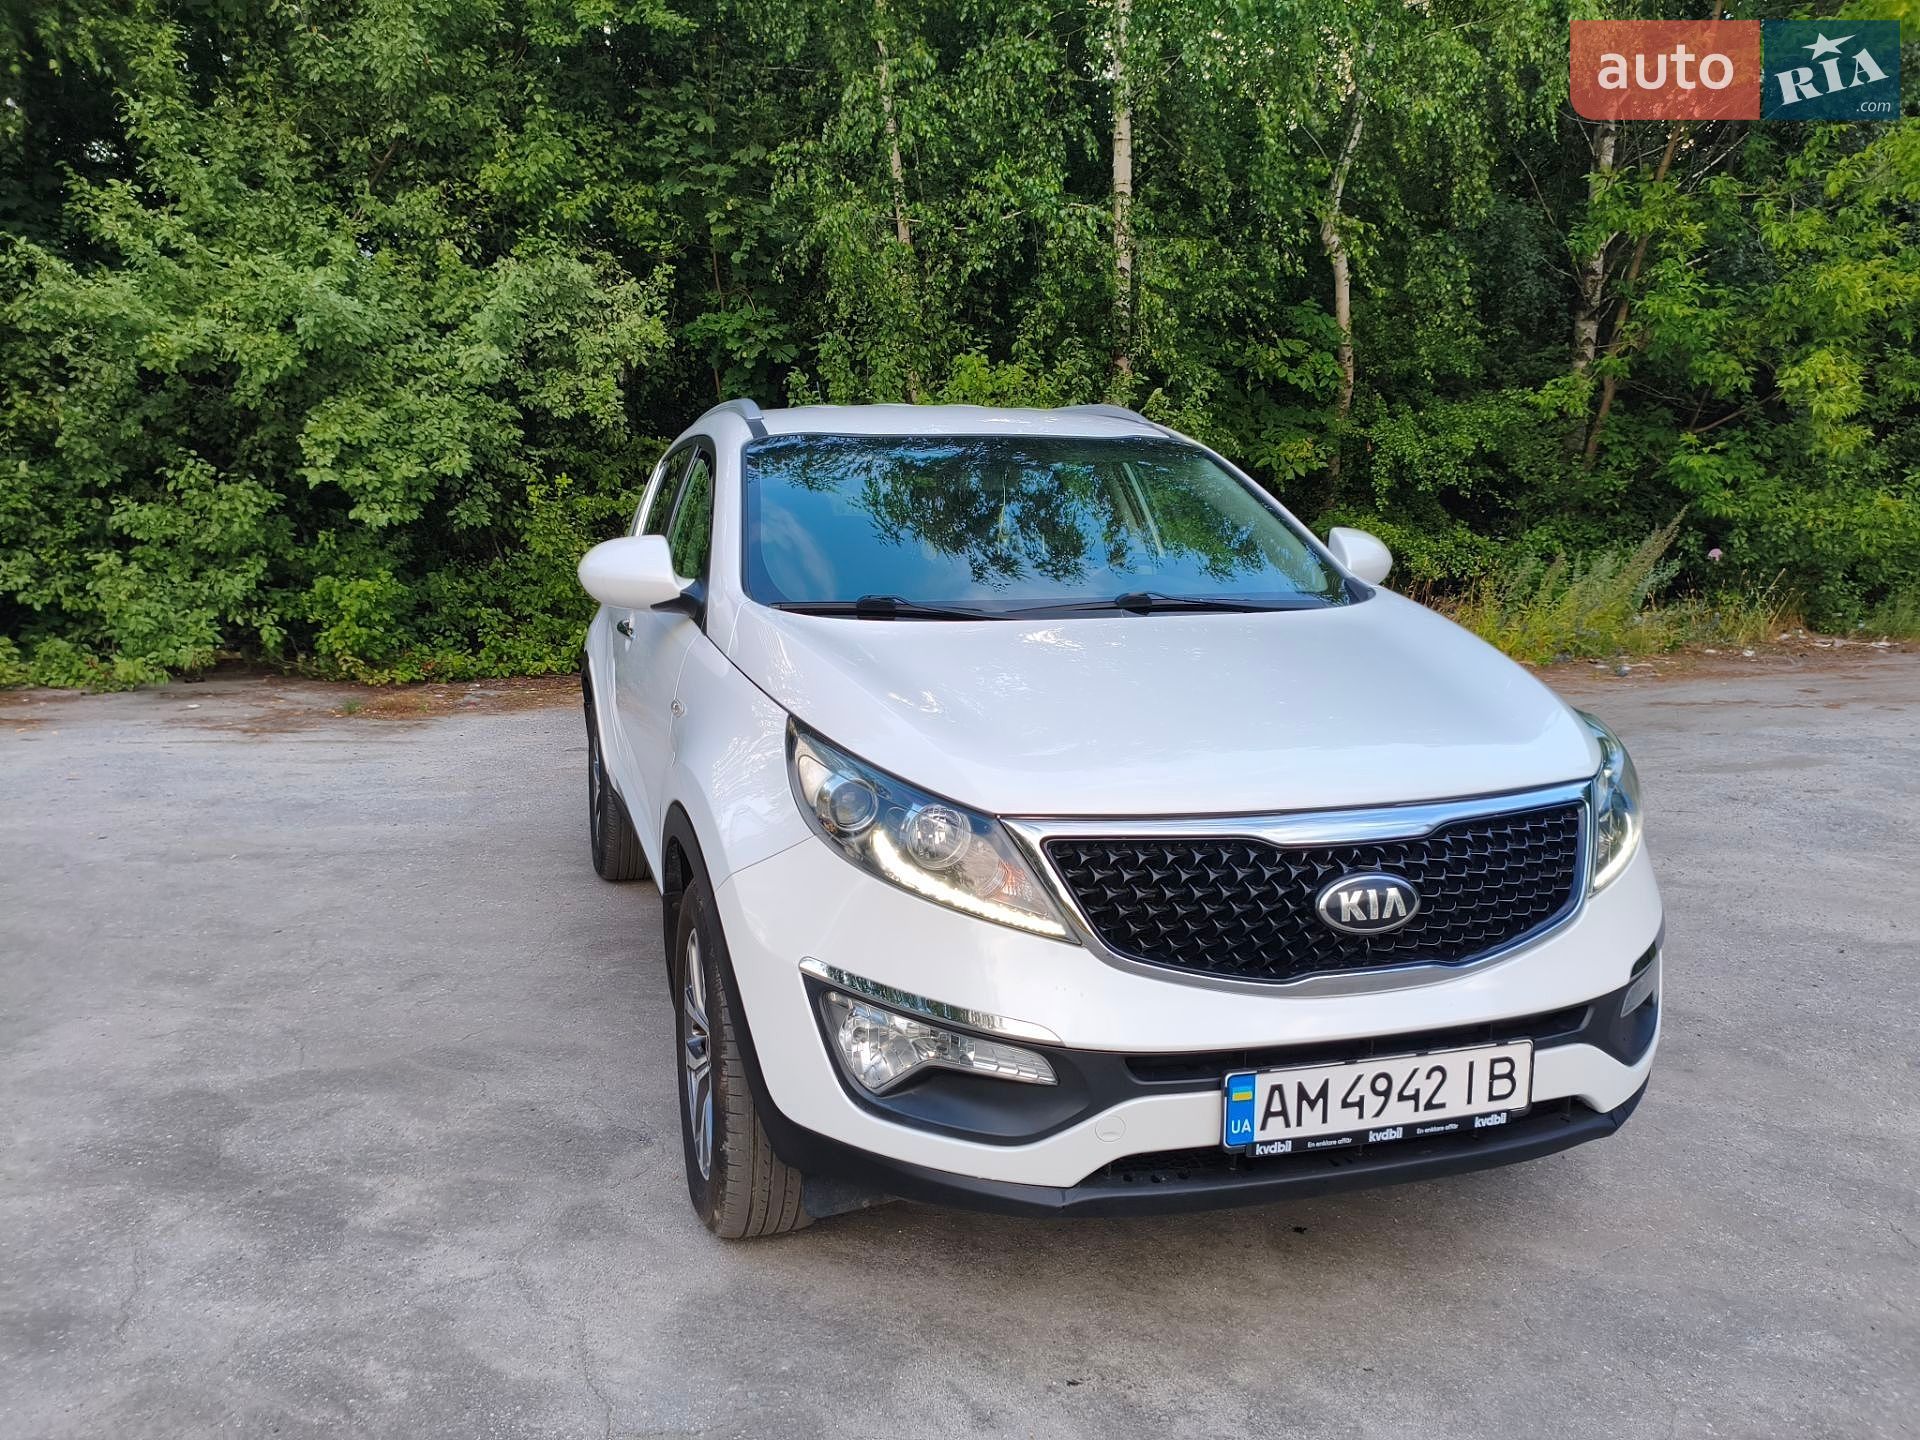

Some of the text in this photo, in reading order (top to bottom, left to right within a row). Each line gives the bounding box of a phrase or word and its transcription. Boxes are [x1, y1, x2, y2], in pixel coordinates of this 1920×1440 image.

[1338, 887, 1407, 923] KIA
[1260, 1078, 1329, 1131] AM
[1341, 1064, 1448, 1120] 4942
[1231, 1120, 1251, 1134] UA
[1255, 1140, 1292, 1155] kvdbil
[1368, 1127, 1403, 1142] kvdbil
[1474, 1112, 1507, 1128] kvdbil
